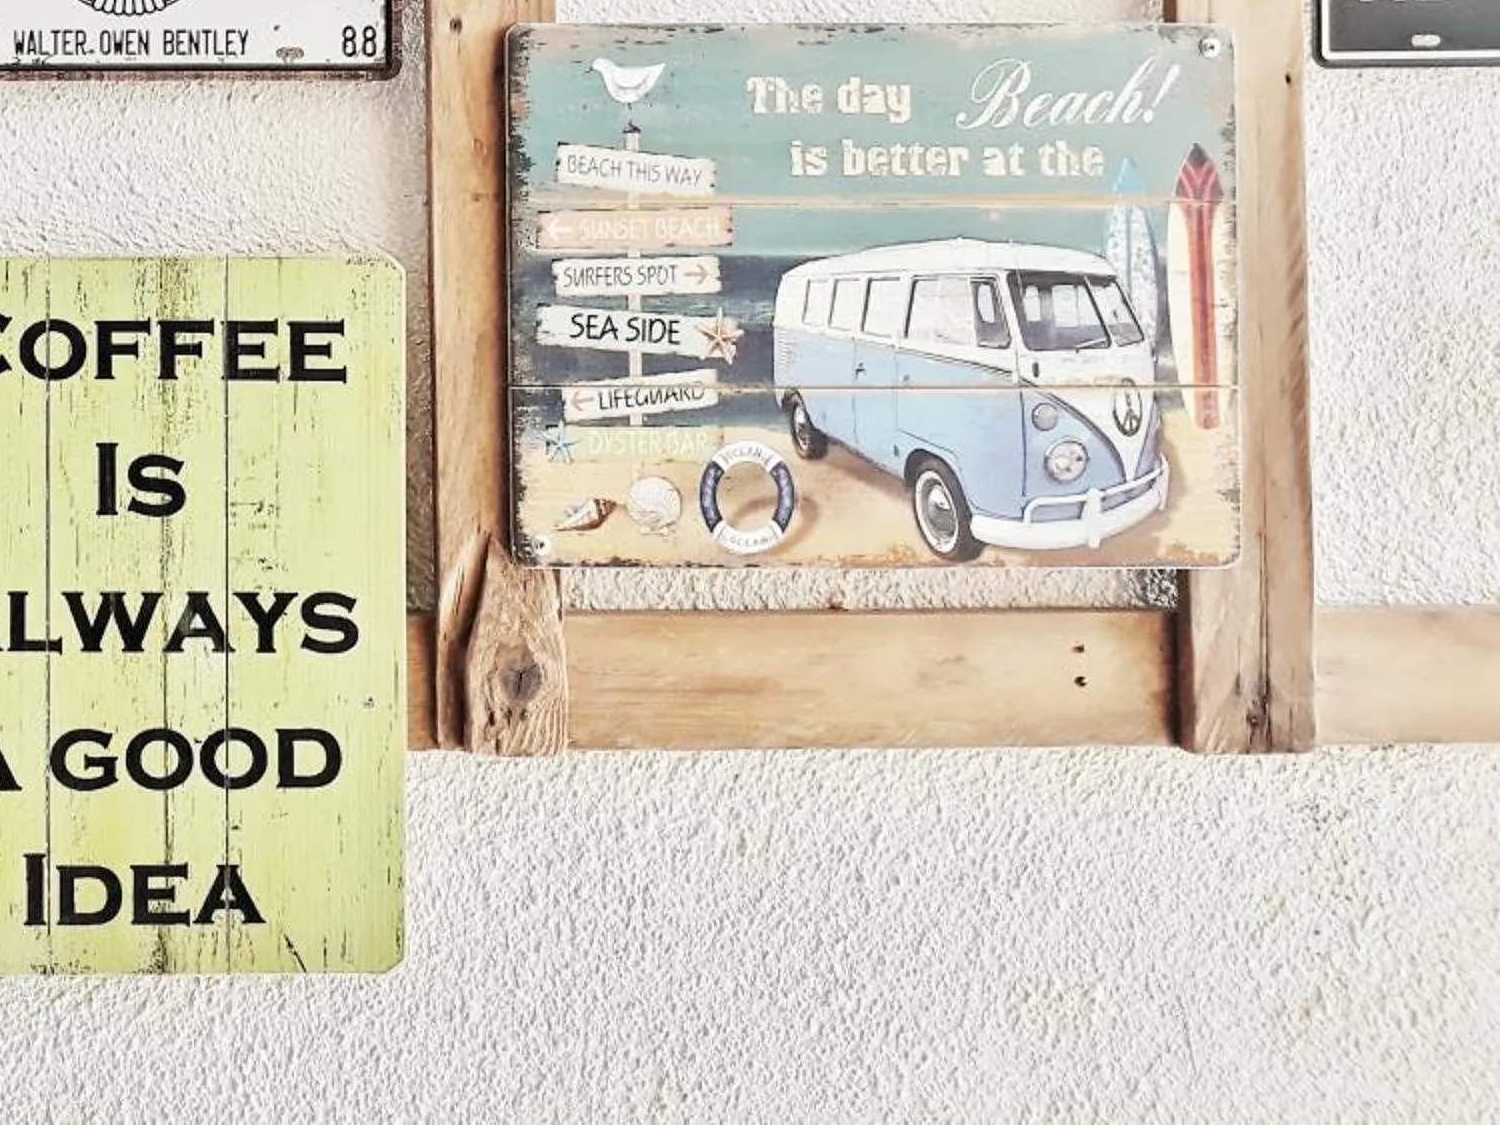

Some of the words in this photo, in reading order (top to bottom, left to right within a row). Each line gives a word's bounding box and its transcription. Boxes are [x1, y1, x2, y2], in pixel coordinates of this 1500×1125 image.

[13, 29, 87, 55] WALTER
[100, 29, 149, 56] OWEN
[163, 28, 249, 56] BENTLEY
[341, 25, 377, 59] 88
[746, 74, 824, 116] The
[837, 75, 913, 124] day
[954, 56, 1182, 132] Beach!
[566, 154, 622, 177] BEACH
[626, 160, 660, 183] THIS
[665, 166, 703, 187] WAY
[789, 138, 829, 178] is
[842, 137, 971, 178] better
[983, 141, 1025, 177] at
[1038, 139, 1105, 177] the
[579, 218, 649, 242] SUNSET
[654, 216, 720, 240] BEACH
[563, 266, 633, 288] SURFERS
[637, 264, 678, 287] SPOT
[569, 313, 619, 342] SEA
[625, 315, 682, 345] SIDE
[597, 382, 706, 411] LIFEGUARD
[95, 441, 188, 518] IS
[48, 726, 343, 793] GOOD
[21, 852, 268, 929] IDEA
